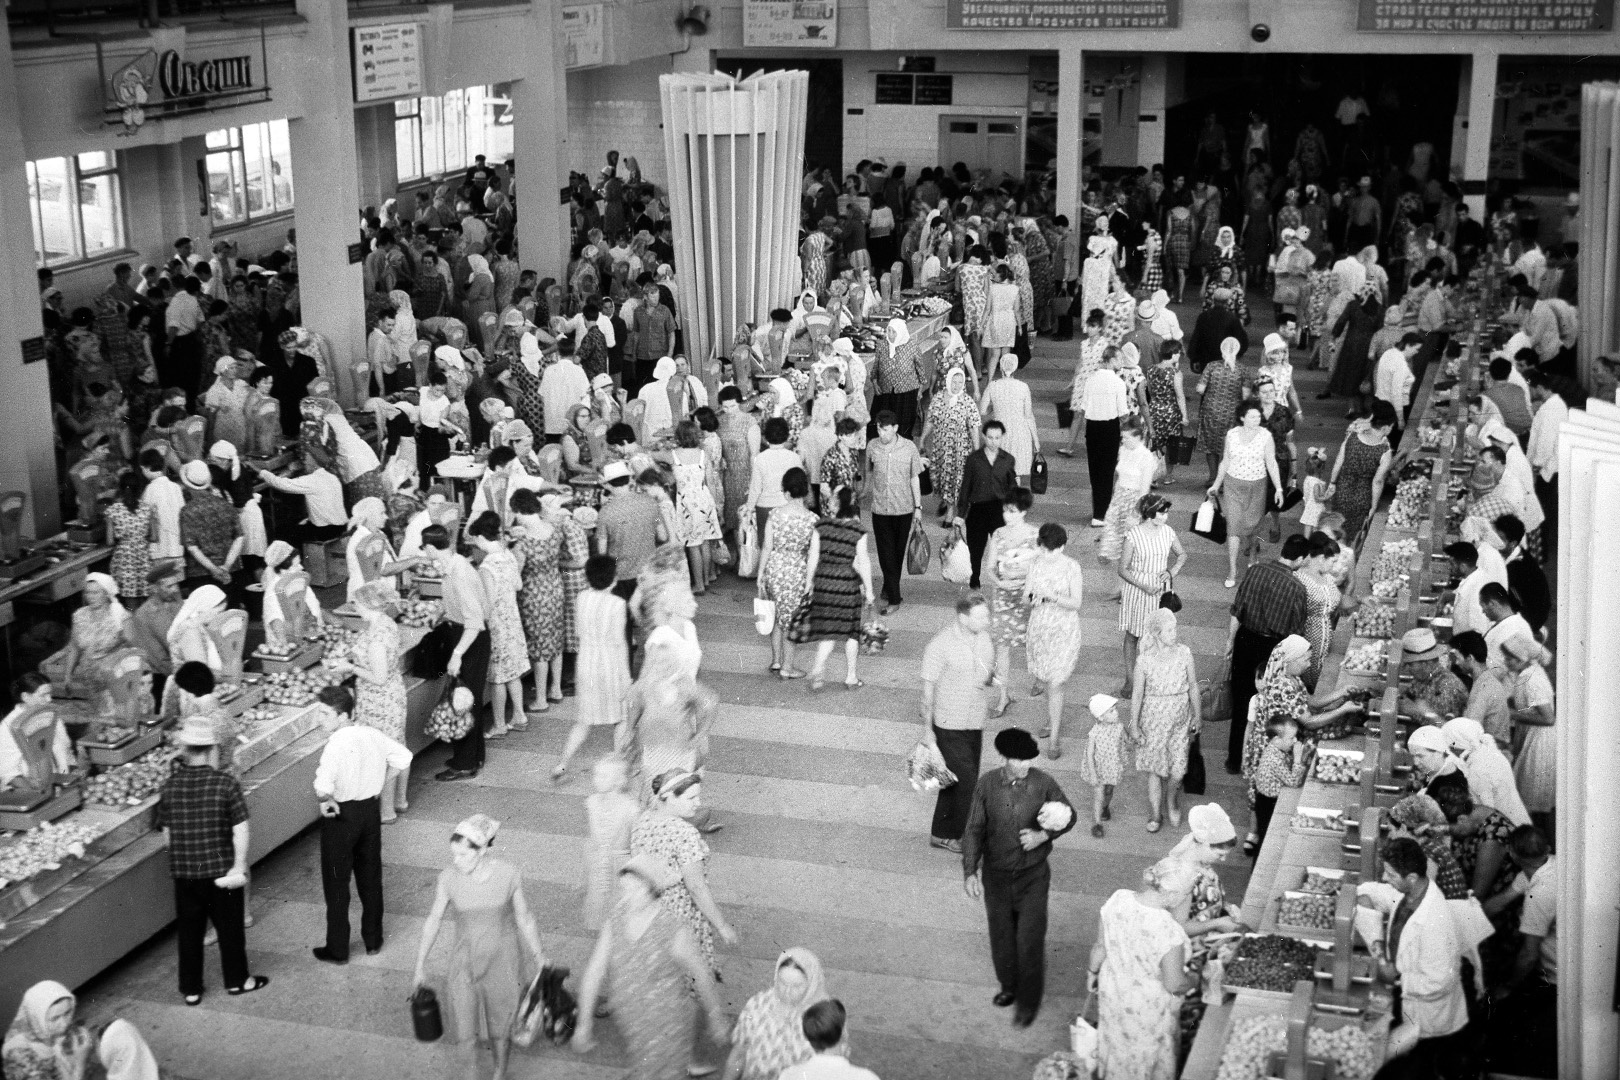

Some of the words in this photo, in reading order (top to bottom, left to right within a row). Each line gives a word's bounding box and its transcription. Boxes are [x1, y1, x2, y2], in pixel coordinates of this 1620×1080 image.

[1375, 5, 1450, 16] СТРОИТЕЛЮ
[1544, 6, 1594, 17] БОРЦУ
[962, 17, 1023, 26] КАЧЕСТВО
[1027, 17, 1099, 27] ПРОДУКТОВ
[1375, 18, 1390, 29] ЗА
[1393, 18, 1413, 29] МИР
[1426, 18, 1472, 30] СЧАСТЬЕ
[159, 49, 252, 98] Овощи
